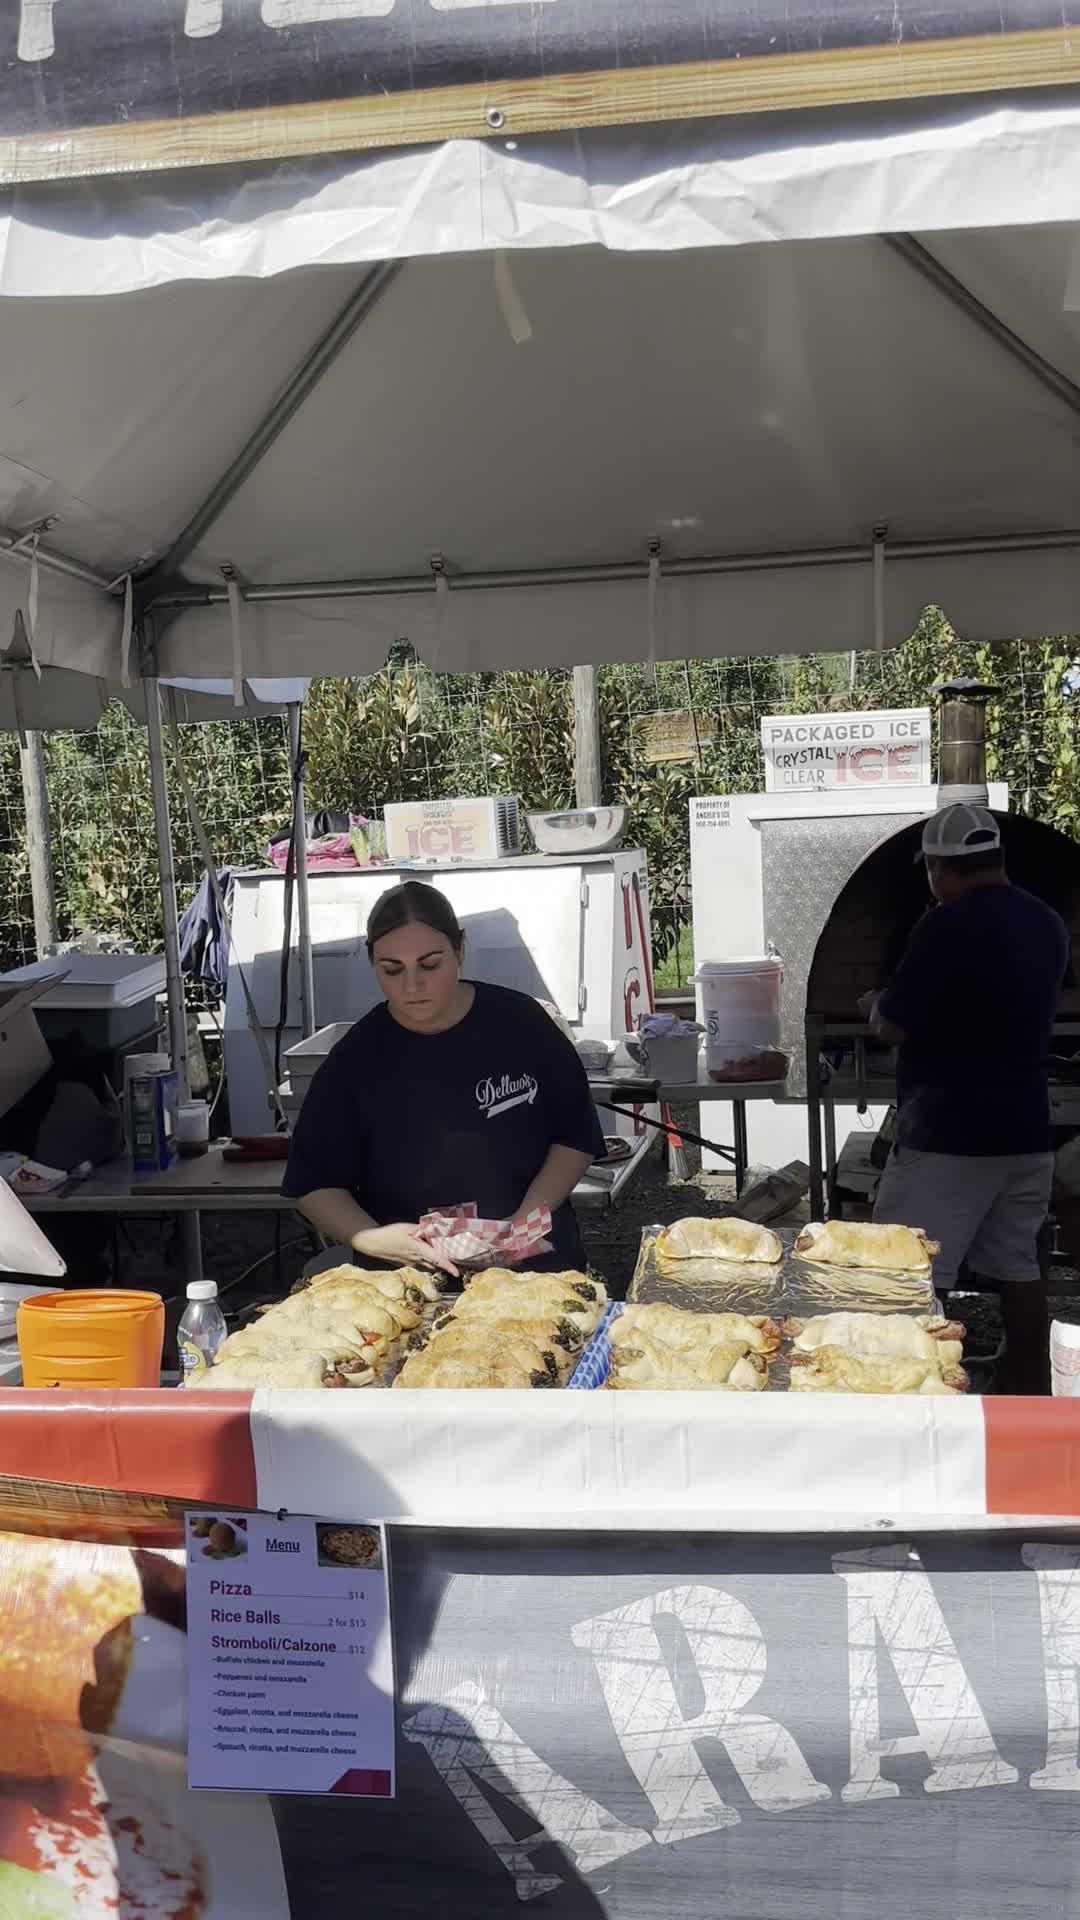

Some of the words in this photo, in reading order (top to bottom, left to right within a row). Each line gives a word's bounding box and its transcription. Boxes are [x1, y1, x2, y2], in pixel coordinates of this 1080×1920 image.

[771, 724, 875, 743] PACKAGED
[890, 721, 921, 738] ICE
[776, 746, 833, 768] CRYSTAL
[833, 743, 920, 783] ICE
[783, 769, 825, 785] CLEAR
[404, 824, 477, 855] ICE
[265, 1538, 301, 1552] Menu
[210, 1580, 252, 1596] Pizza
[349, 1591, 365, 1600] $14
[211, 1609, 242, 1623] Rice
[246, 1610, 281, 1625] Balls
[328, 1618, 333, 1627] 2
[335, 1617, 347, 1628] for
[211, 1635, 337, 1653] Stromboli/Calzone
[272, 1658, 285, 1666] and
[278, 1709, 292, 1717] and
[292, 1711, 331, 1719] mozzarella
[333, 1712, 358, 1720] cheese
[290, 1728, 330, 1736] mozzarella
[331, 1729, 357, 1737] cheese
[290, 1746, 329, 1754] mozzarella
[330, 1747, 357, 1755] cheese
